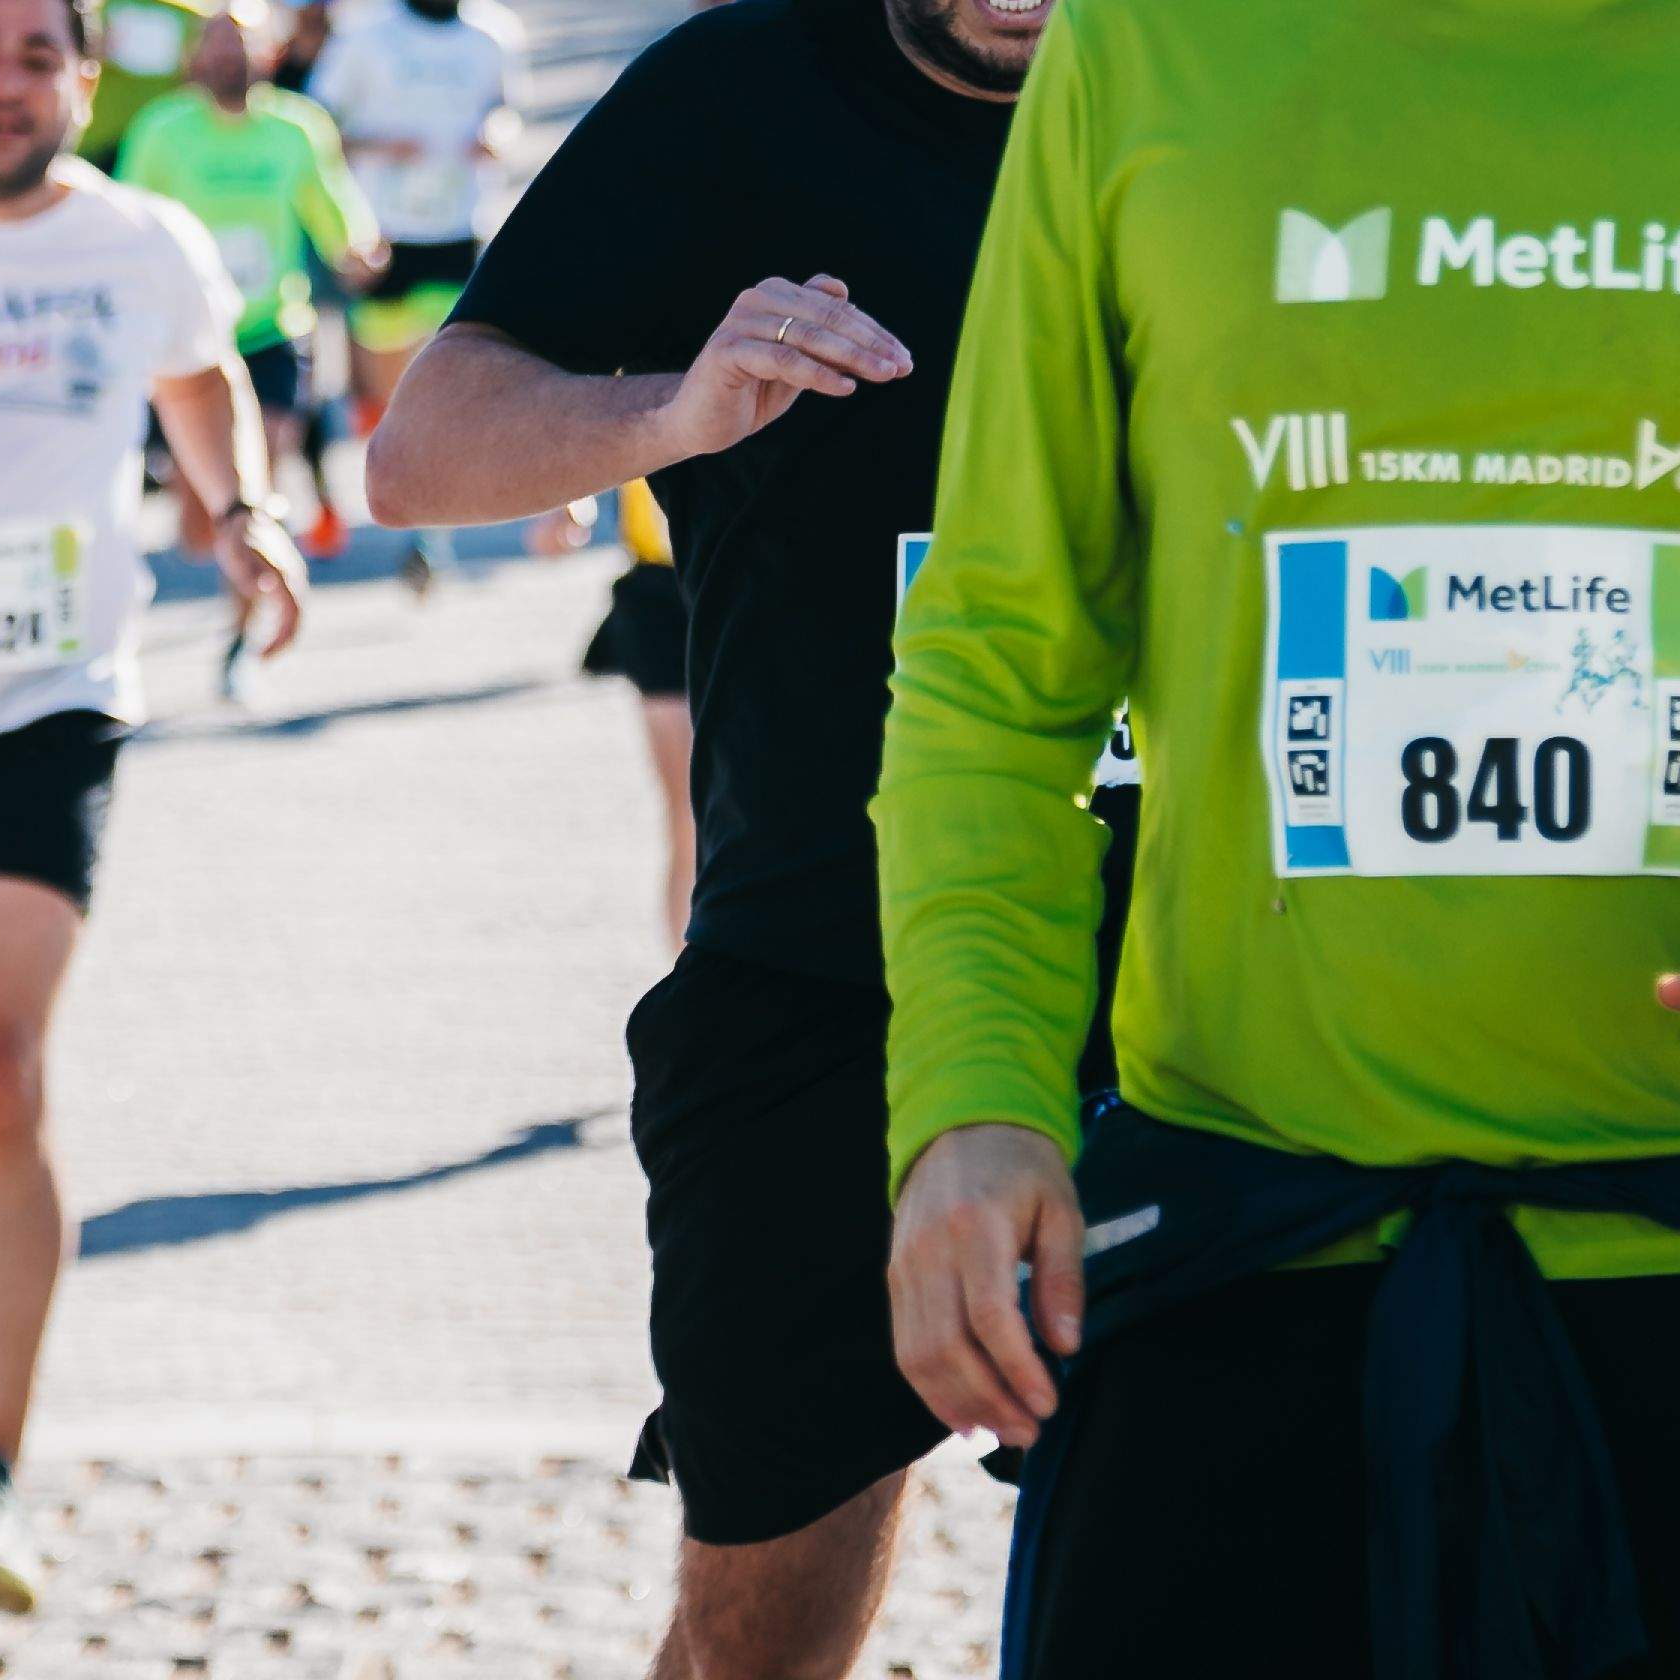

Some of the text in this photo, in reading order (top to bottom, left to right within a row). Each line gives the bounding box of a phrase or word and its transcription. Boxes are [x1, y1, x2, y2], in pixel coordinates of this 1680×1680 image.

[1231, 412, 1349, 492] VIII
[1359, 452, 1460, 484] 15KM
[1446, 573, 1633, 615] MetLife
[1400, 736, 1594, 844] 840
